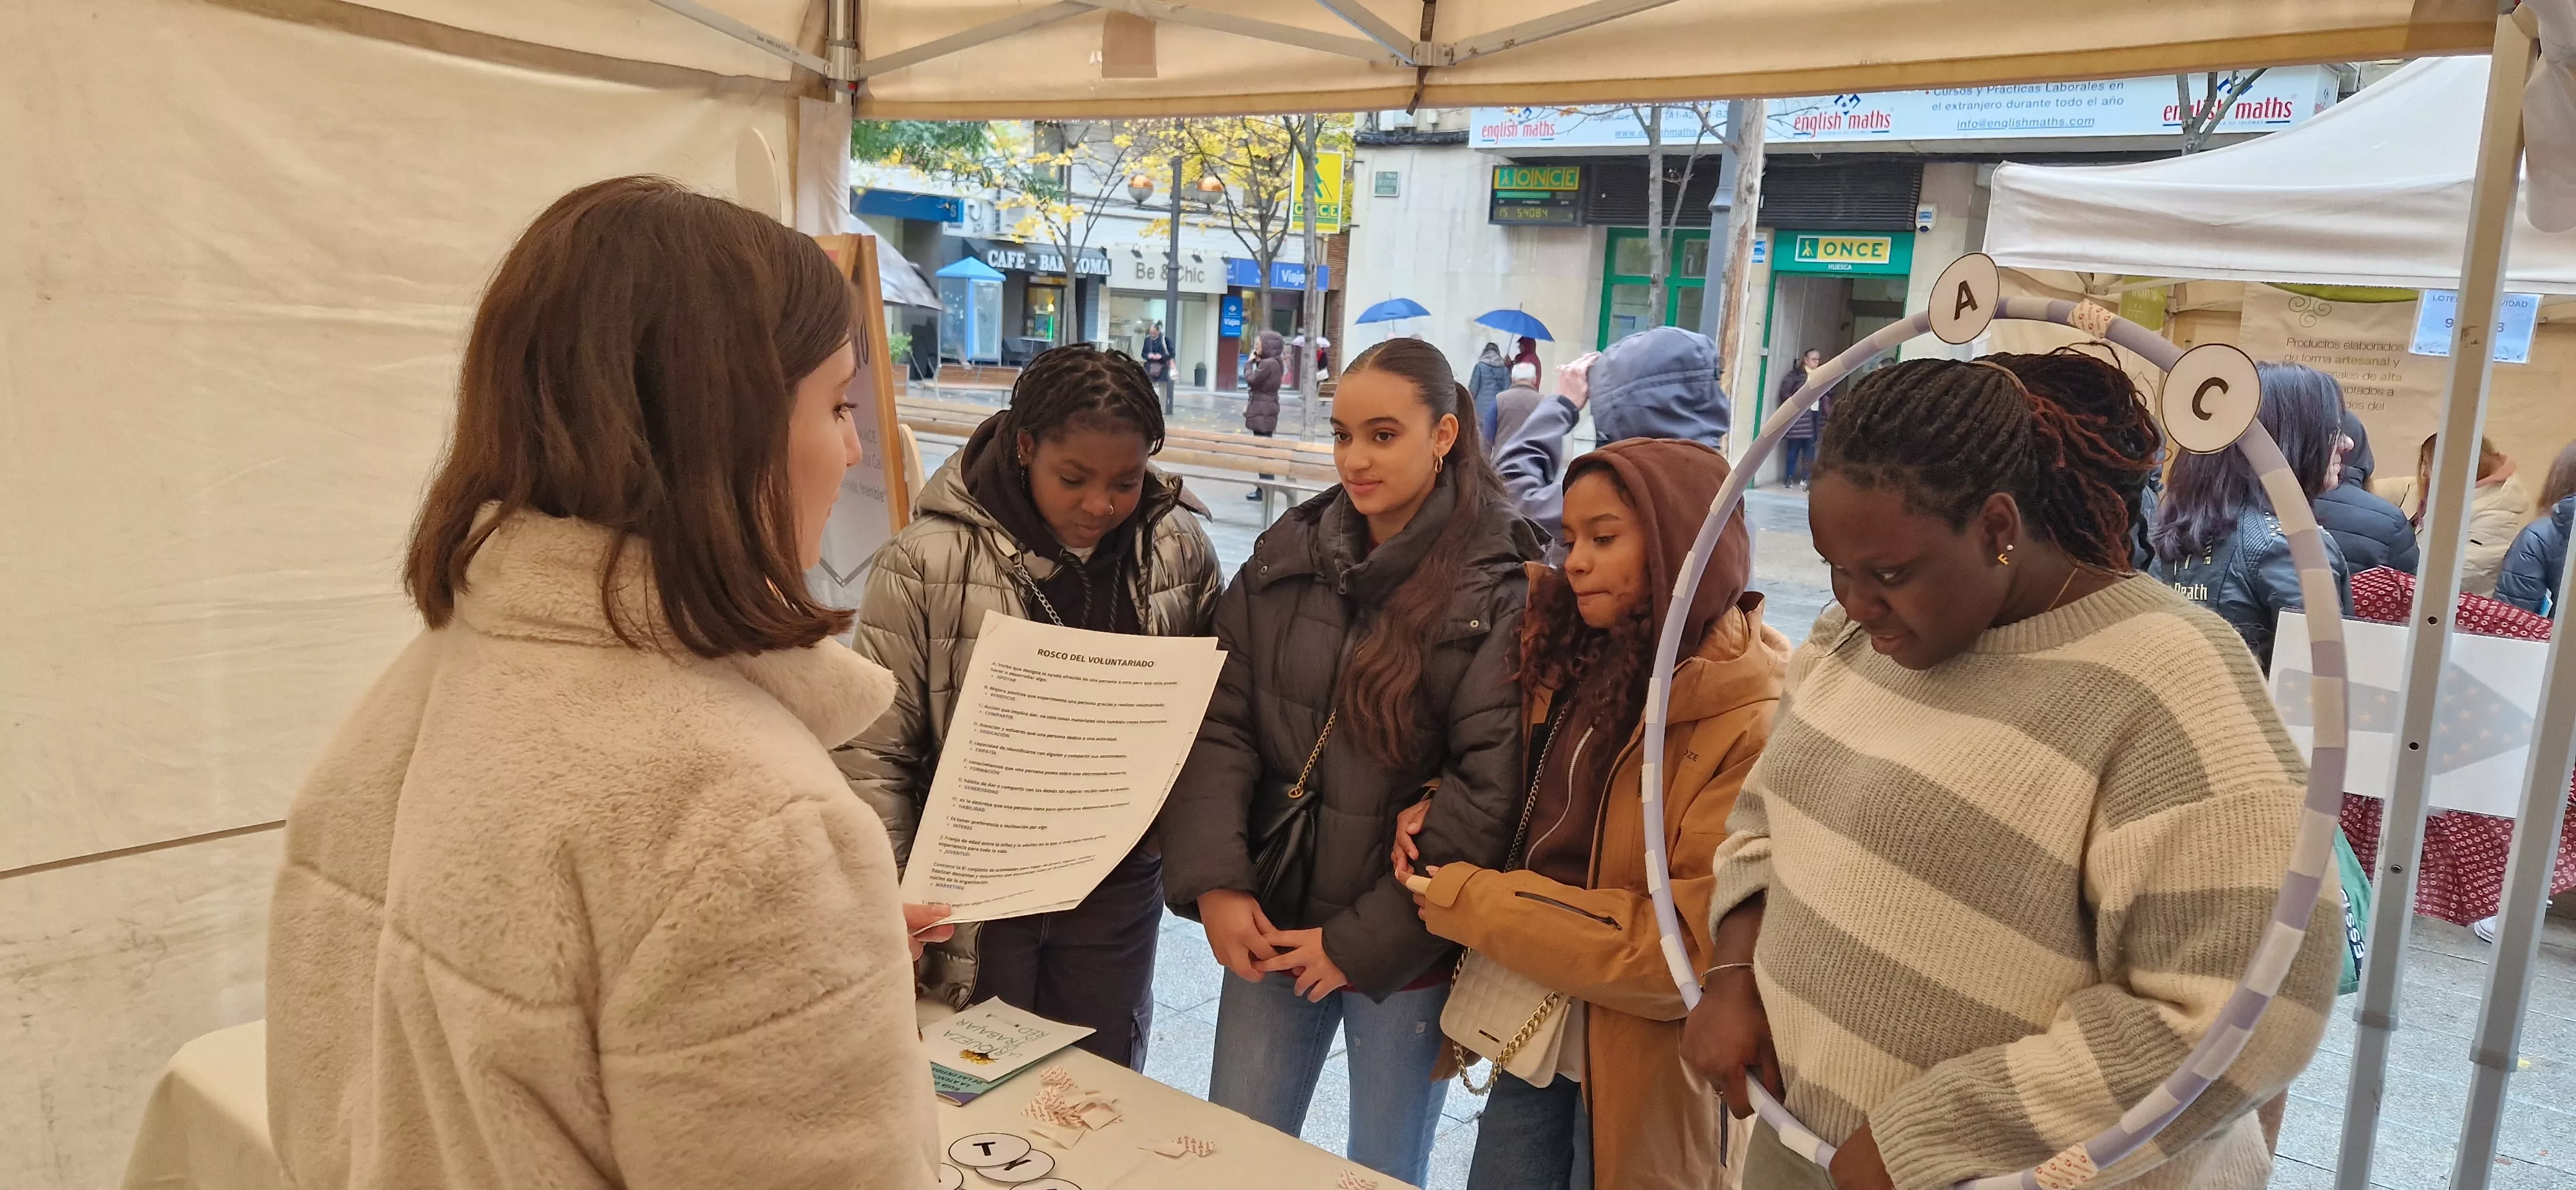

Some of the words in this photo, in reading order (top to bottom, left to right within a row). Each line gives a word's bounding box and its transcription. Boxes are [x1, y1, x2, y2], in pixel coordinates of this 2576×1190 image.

[2046, 82, 2105, 93] Laborales
[2109, 82, 2123, 91] en
[1932, 102, 1941, 111] el
[1945, 100, 2002, 111] extranjero
[2006, 99, 2051, 109] durante
[2056, 97, 2083, 108] todo
[2087, 97, 2097, 106] el
[2101, 96, 2124, 106] año
[2235, 97, 2293, 118] maths
[1795, 111, 1842, 138] english
[1848, 110, 1891, 129] maths
[1956, 117, 2095, 129] info@englishmaths.com
[1482, 121, 1518, 144] english
[1522, 120, 1555, 137] maths
[1517, 169, 1575, 185] ONCE
[1294, 203, 1338, 217] OCE
[1823, 241, 1883, 258] ONCE
[987, 249, 1026, 269] CAFE
[1136, 261, 1155, 279] Be
[1954, 280, 1978, 321] A
[2286, 337, 2340, 350] Productos
[2343, 341, 2405, 352] elaborados
[2284, 354, 2298, 362] de
[2302, 354, 2332, 364] forma
[2334, 356, 2390, 366] artesanal
[2393, 359, 2400, 368] y
[2362, 372, 2377, 381] de
[2380, 372, 2402, 382] alta
[2192, 377, 2230, 420] C
[2367, 402, 2385, 411] del
[1037, 648, 1068, 660] ROSCO
[1070, 654, 1086, 663] DEL
[1088, 656, 1154, 668] VOLUNTARIADO
[956, 1019, 1025, 1047] TRABAJAR
[1018, 1027, 1050, 1038] RED
[972, 1141, 996, 1157] T
